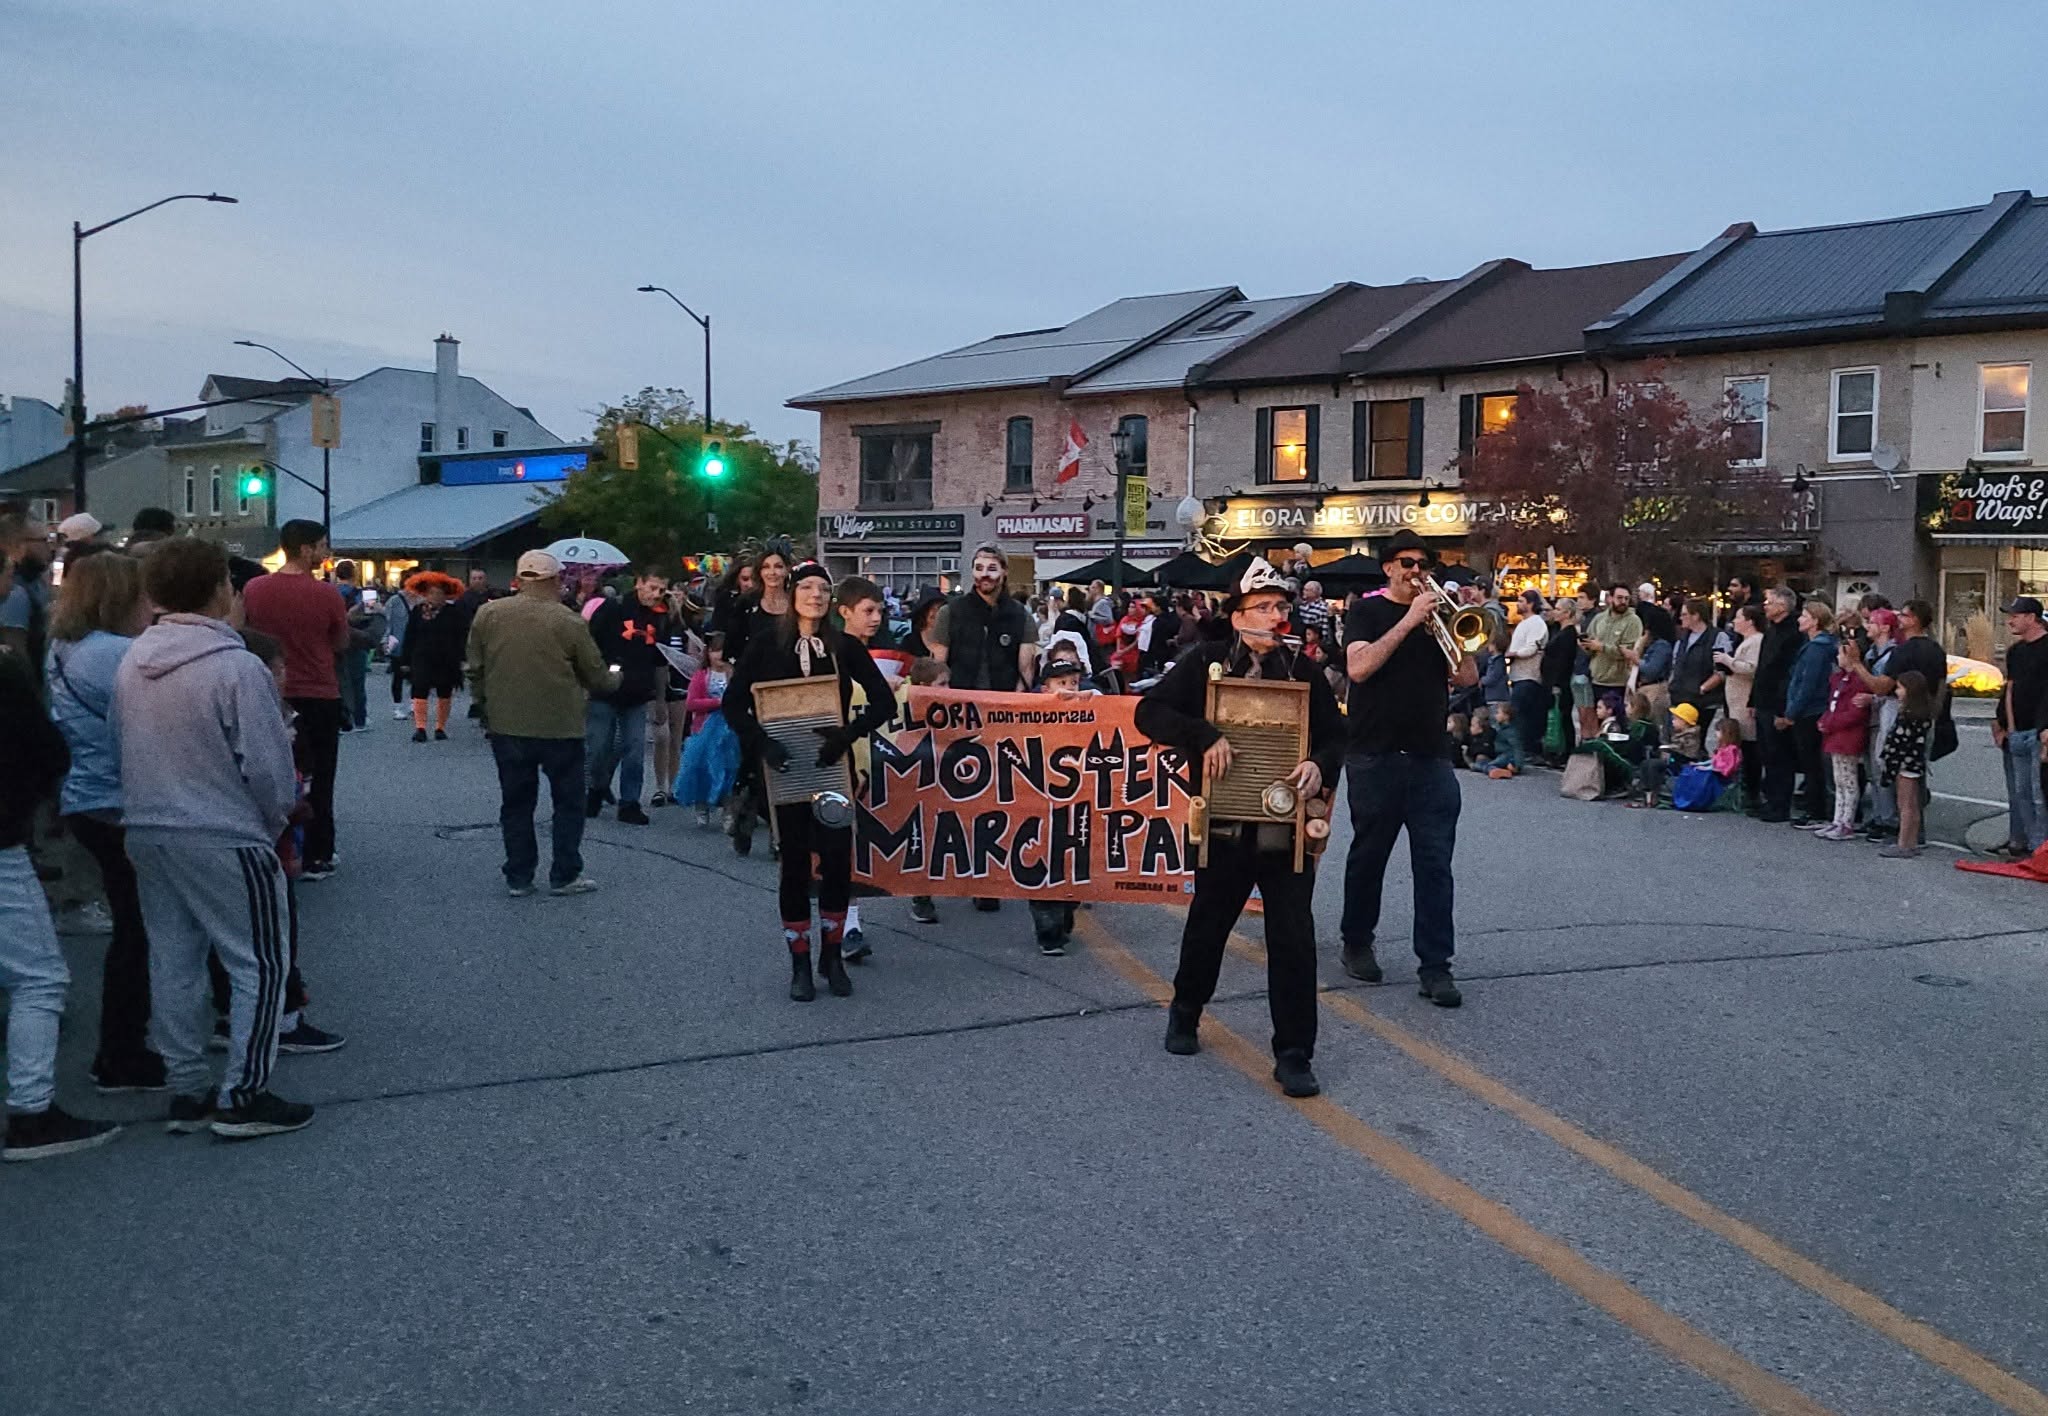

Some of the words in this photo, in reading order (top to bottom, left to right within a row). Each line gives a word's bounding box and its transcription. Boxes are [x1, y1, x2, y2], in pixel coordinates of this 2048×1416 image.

[2028, 479, 2044, 500] &
[833, 513, 875, 540] Village
[876, 520, 904, 529] HAIR
[909, 520, 957, 529] STUDIO
[997, 516, 1085, 534] PHARMASAVE
[1237, 507, 1307, 527] ELORA
[1313, 504, 1418, 526] BREWING
[1975, 499, 2048, 527] Wags!
[888, 701, 983, 734] ELORA
[986, 709, 1096, 725] non-motorized
[869, 727, 1191, 812] MONSTER
[851, 797, 1093, 890] MARCH
